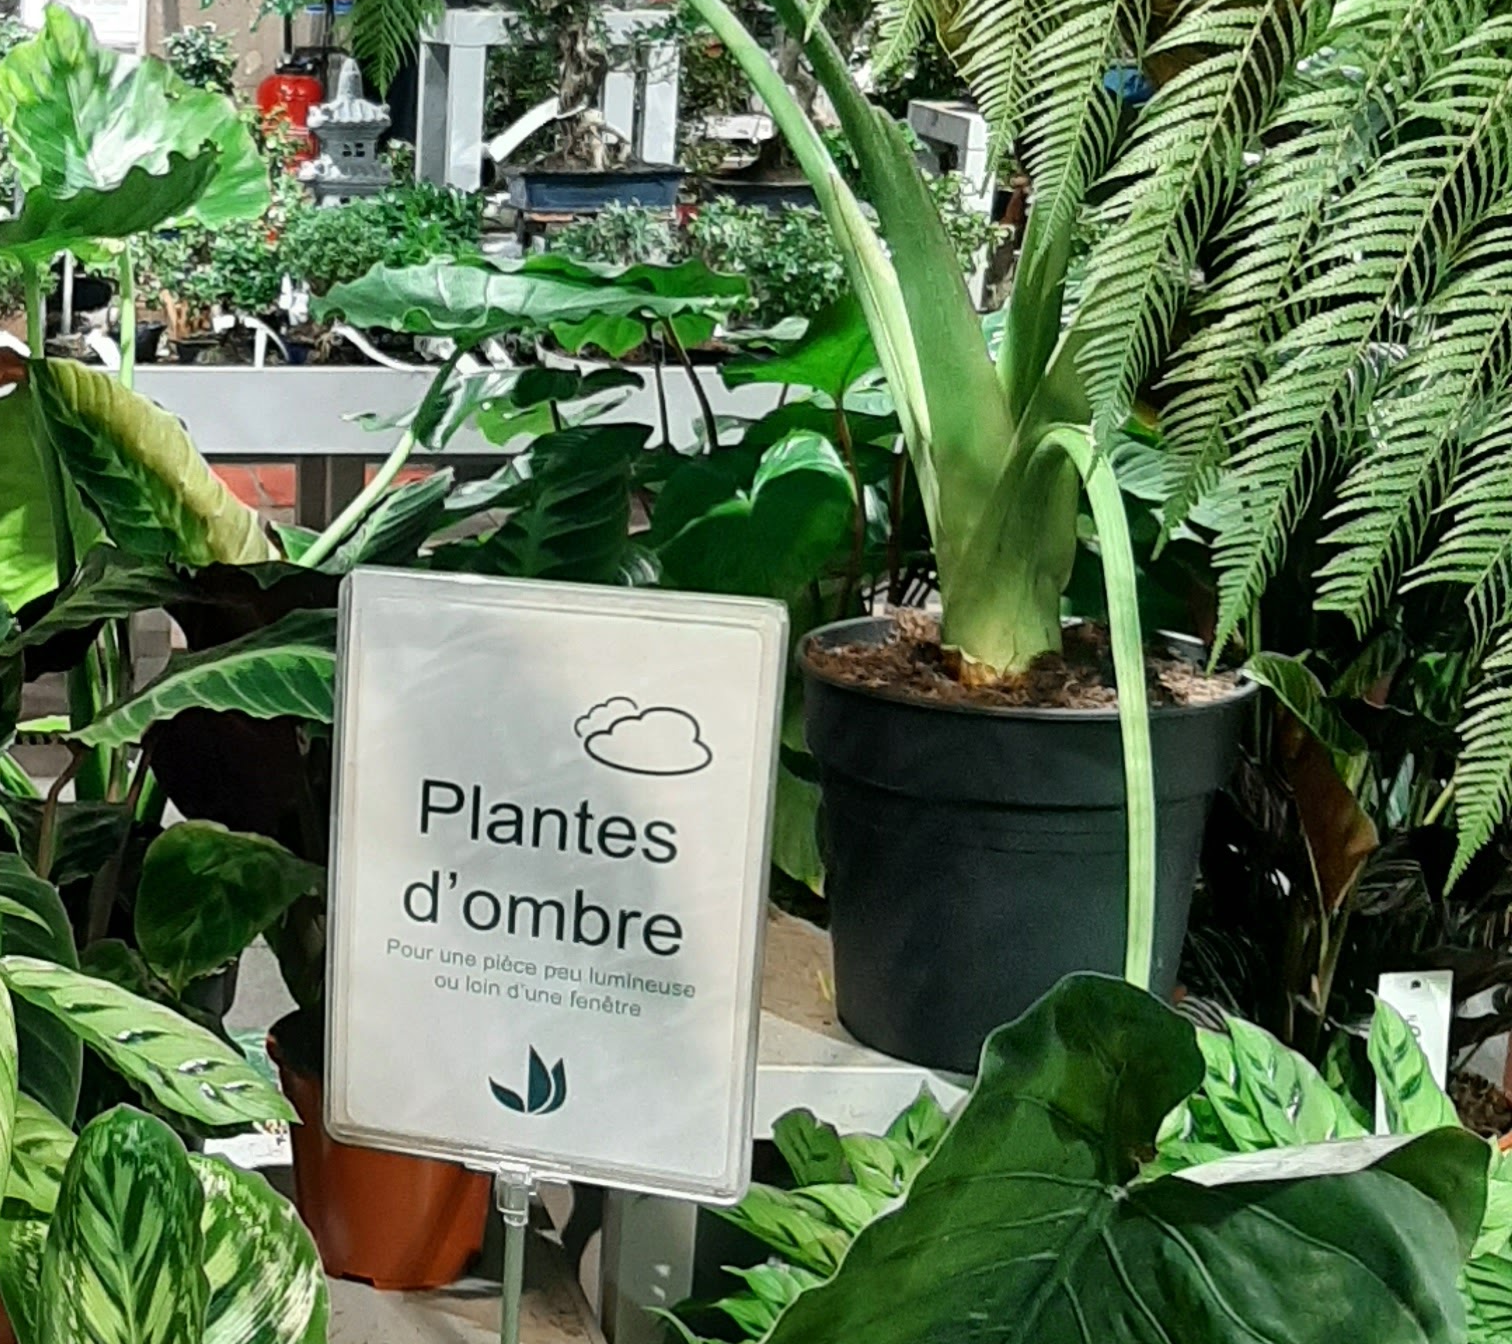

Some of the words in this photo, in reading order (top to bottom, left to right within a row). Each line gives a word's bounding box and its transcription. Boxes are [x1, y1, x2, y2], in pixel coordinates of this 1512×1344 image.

[419, 778, 679, 864] Plantes
[402, 869, 683, 957] d'ombre
[386, 937, 434, 961] Pour
[439, 948, 477, 968] une
[483, 953, 538, 976] pièce
[544, 964, 582, 982] peu
[589, 966, 696, 999] lumineuse
[434, 974, 459, 991] ou
[465, 974, 501, 997] loin
[507, 983, 562, 1006] d'une
[570, 989, 642, 1017] fenêtre
